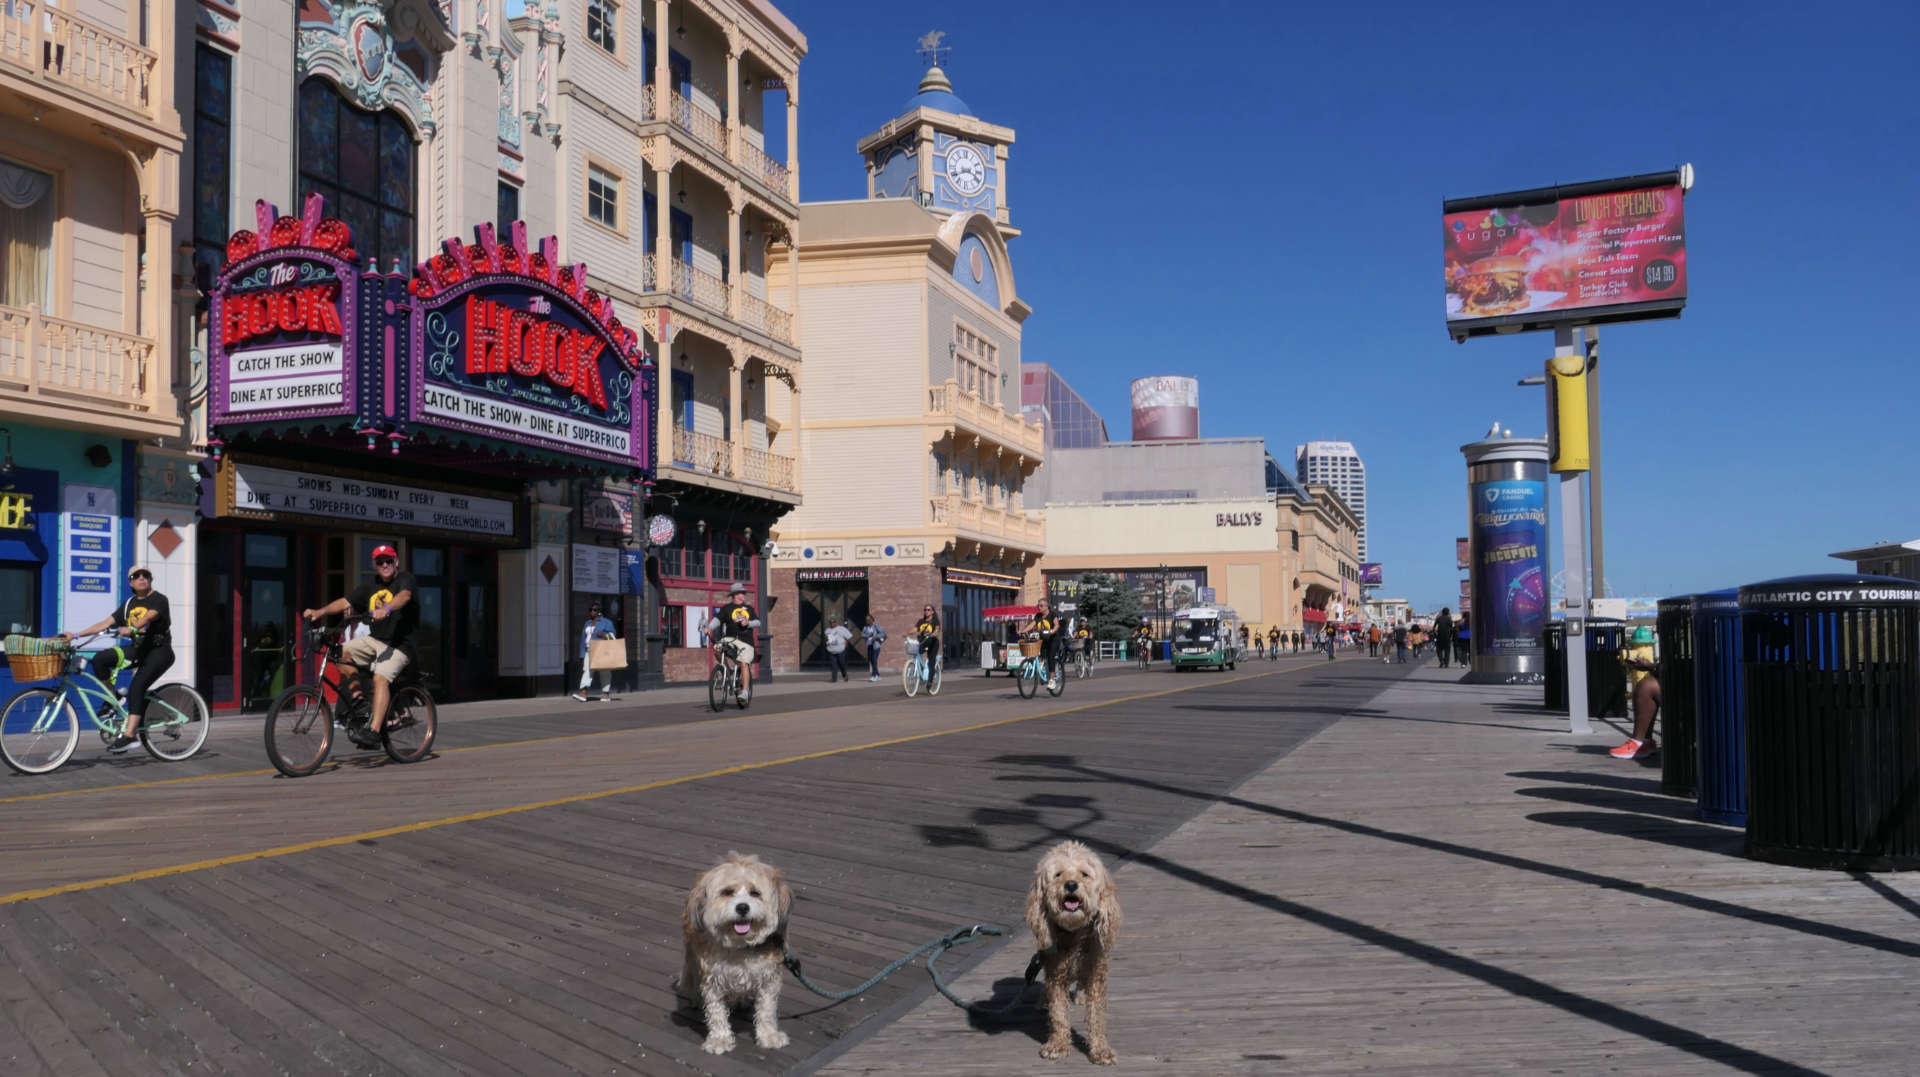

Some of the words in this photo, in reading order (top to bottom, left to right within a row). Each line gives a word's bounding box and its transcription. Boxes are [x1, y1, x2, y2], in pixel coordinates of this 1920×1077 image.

[1575, 195, 1610, 223] LUNCH
[1615, 189, 1665, 217] SPECIALS
[1603, 226, 1634, 236] Factory
[1636, 223, 1665, 232] Burger
[270, 262, 298, 287] The
[1610, 265, 1634, 275] Salad
[222, 284, 343, 345] HOOK
[529, 295, 552, 315] The
[238, 357, 271, 372] CATCH
[275, 354, 296, 368] THE
[300, 351, 335, 366] SHOW
[466, 294, 609, 411] HOOK
[230, 389, 257, 403] DINE
[259, 387, 274, 401] AT
[276, 382, 343, 400] SUPERFRICO
[424, 389, 460, 412] CATCH
[464, 398, 486, 418] THE
[490, 404, 522, 426] SHOW
[530, 416, 554, 434] DINE
[557, 420, 569, 436] AT
[572, 425, 627, 451] SUPERFRICO
[298, 476, 332, 493] SHOWS
[343, 484, 400, 501] WED-SUNDAY
[409, 492, 436, 505] EVERY
[450, 498, 470, 510] WEEK
[247, 490, 271, 505] DINE
[284, 496, 297, 508] AT
[309, 498, 367, 517] SUPERFRICO
[378, 507, 415, 522] WED-SUN
[433, 512, 506, 532] SPIEGELWORLD.COM
[1216, 511, 1263, 527] BALLY'S
[1483, 545, 1537, 565] JACKPOTS
[1751, 592, 1812, 604] ATLANTIC
[1816, 591, 1854, 601] CITY
[1858, 589, 1912, 601] TOURISM
